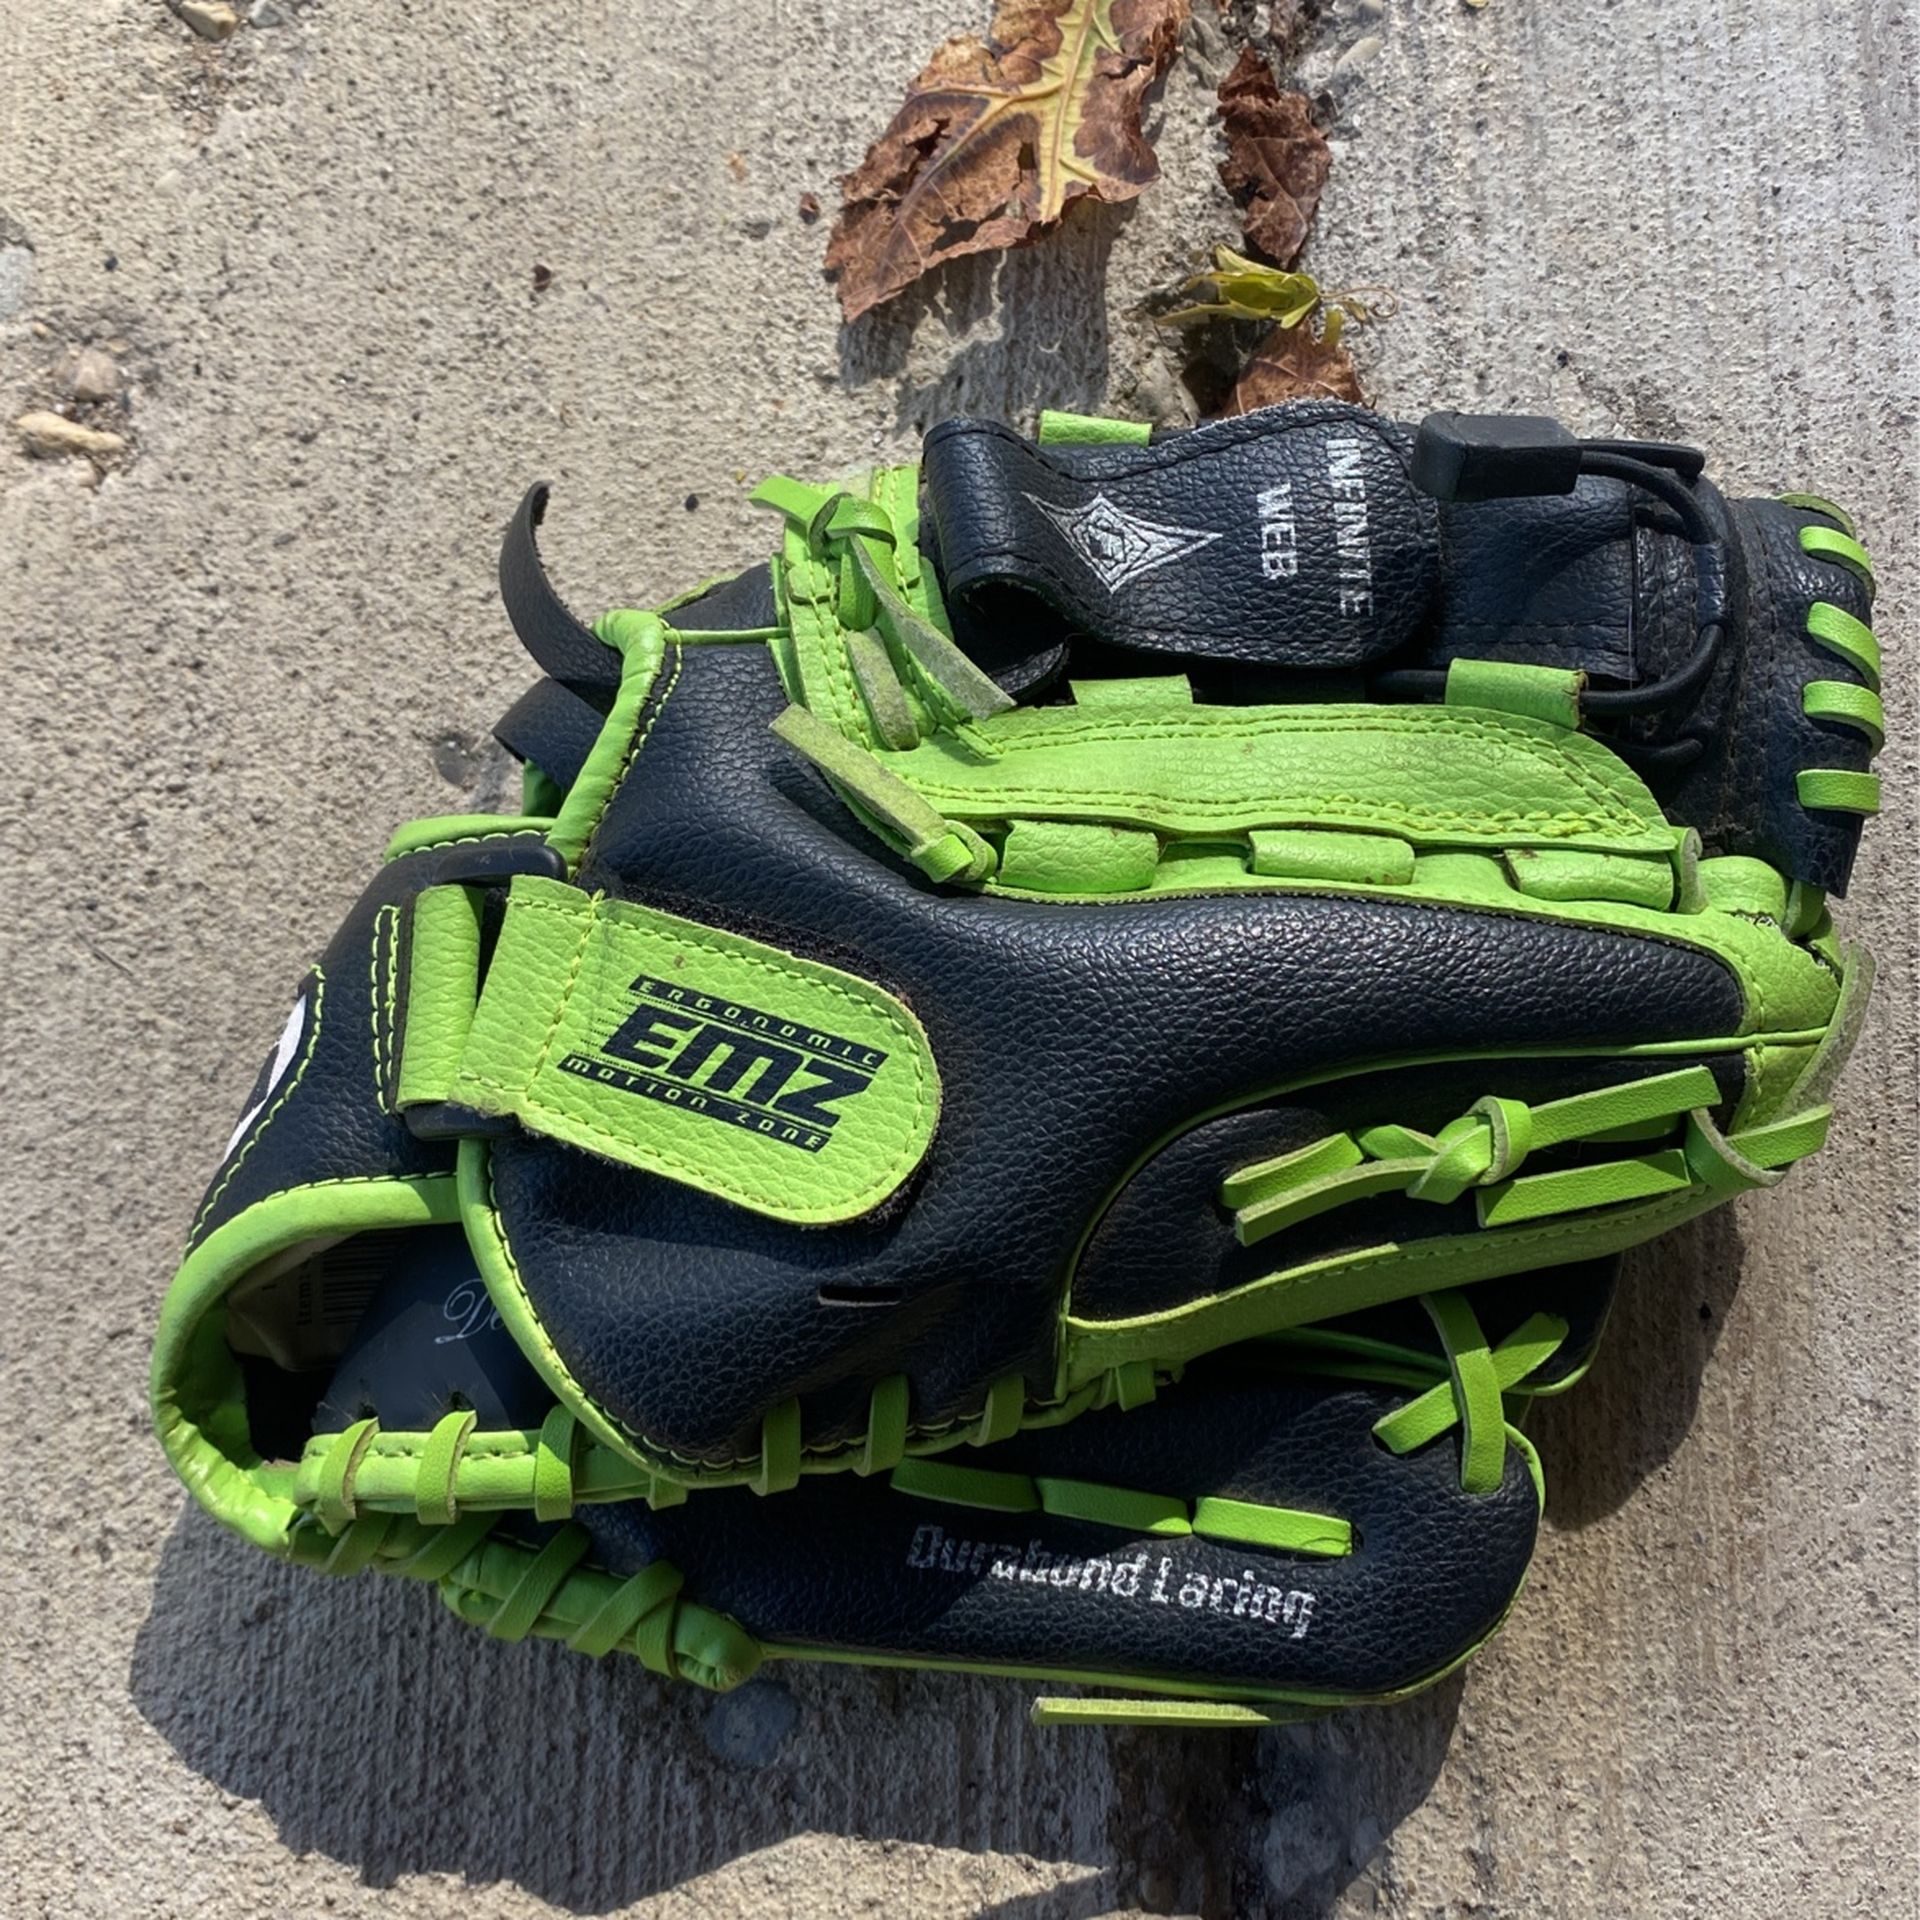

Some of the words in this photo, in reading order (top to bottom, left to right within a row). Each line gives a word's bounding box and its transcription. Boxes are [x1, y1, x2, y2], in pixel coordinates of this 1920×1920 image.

[1256, 484, 1298, 580] WEB
[1325, 438, 1374, 617] INFINITE
[601, 1003, 873, 1128] EMZ
[638, 979, 879, 1066] ERGONOMIC
[565, 1057, 709, 1109] MOTION
[736, 1110, 824, 1147] ZONE
[1150, 1556, 1316, 1639] Lacing
